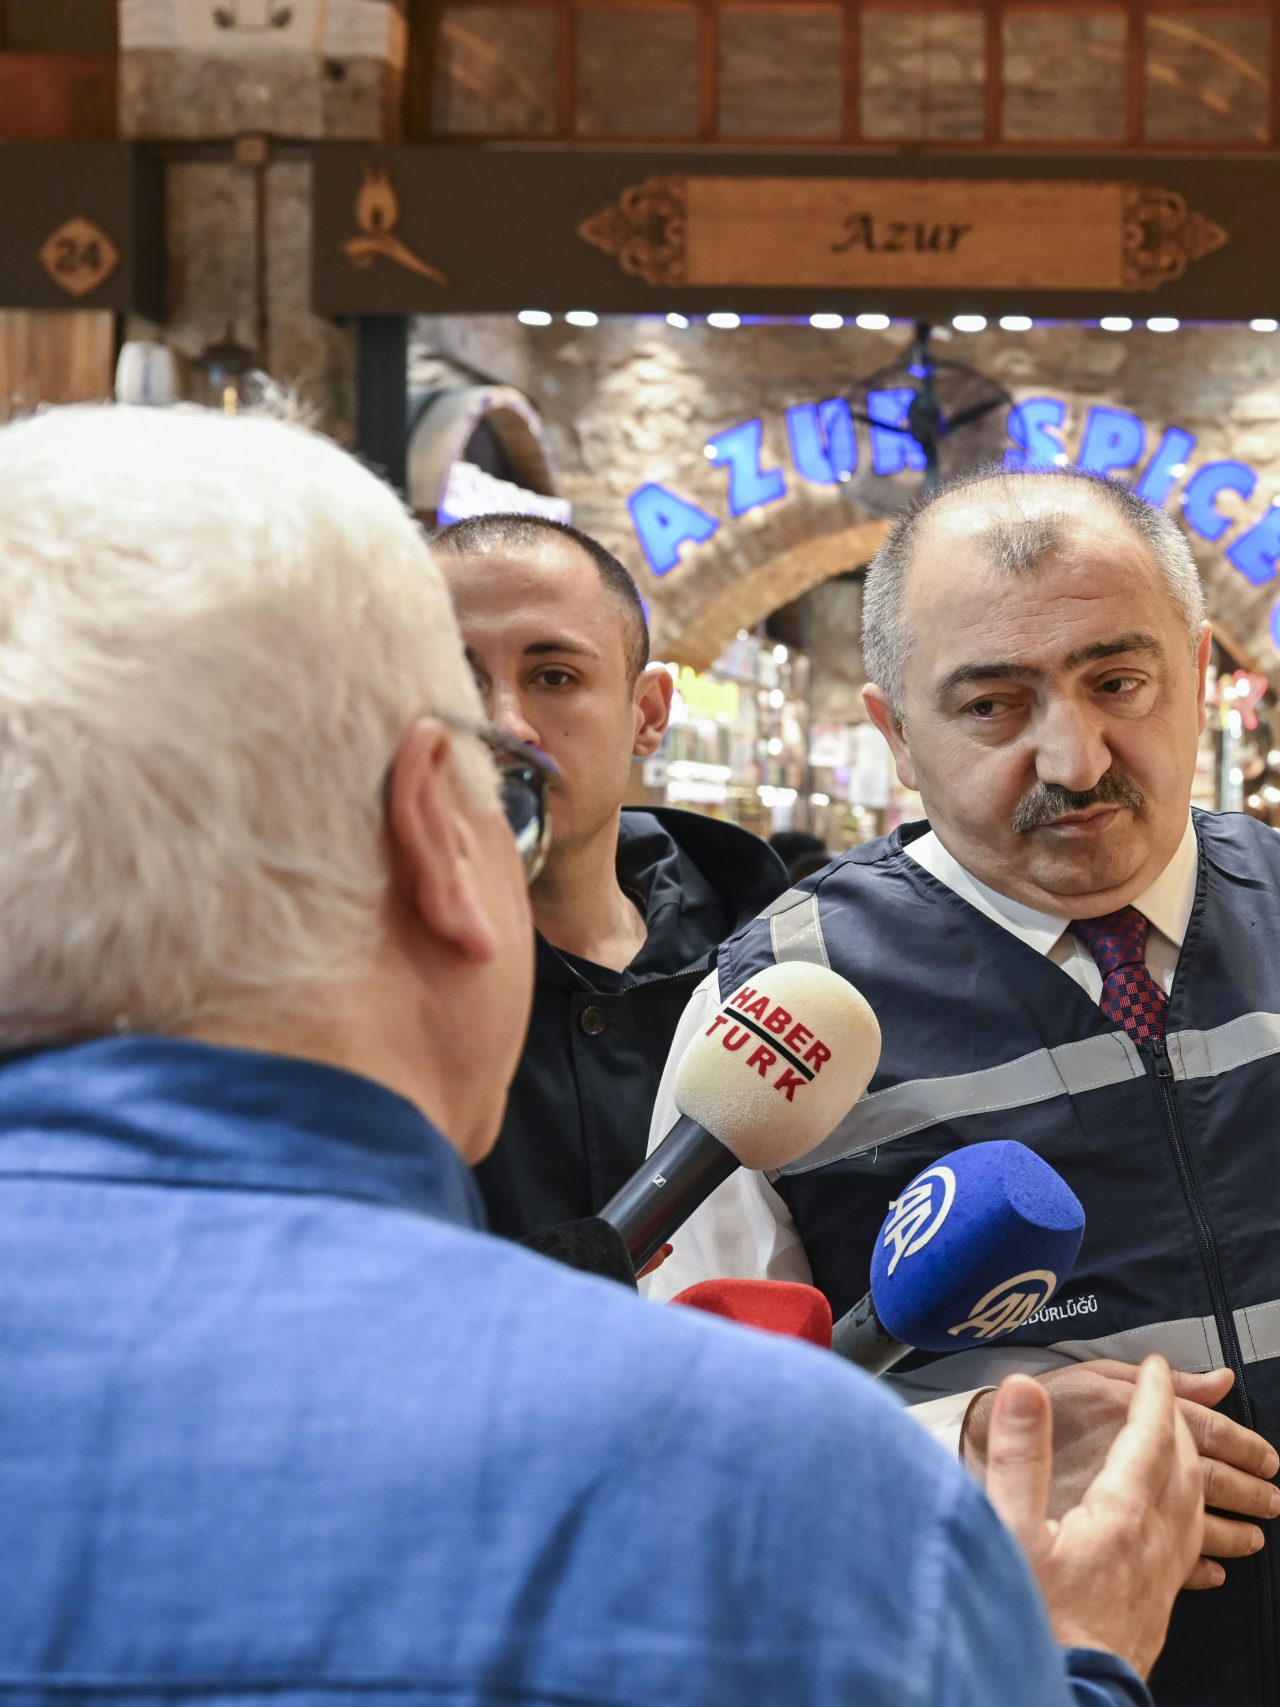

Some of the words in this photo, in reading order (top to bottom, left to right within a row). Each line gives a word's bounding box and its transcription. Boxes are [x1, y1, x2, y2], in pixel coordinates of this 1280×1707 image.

[54, 237, 102, 275] 24
[830, 211, 973, 254] Azur
[626, 387, 928, 576] AZUR
[729, 986, 833, 1074] HABER
[704, 1014, 808, 1103] TURK
[947, 1286, 1044, 1338] AA
[1020, 1294, 1098, 1326] DÜRLÜĞÜ
